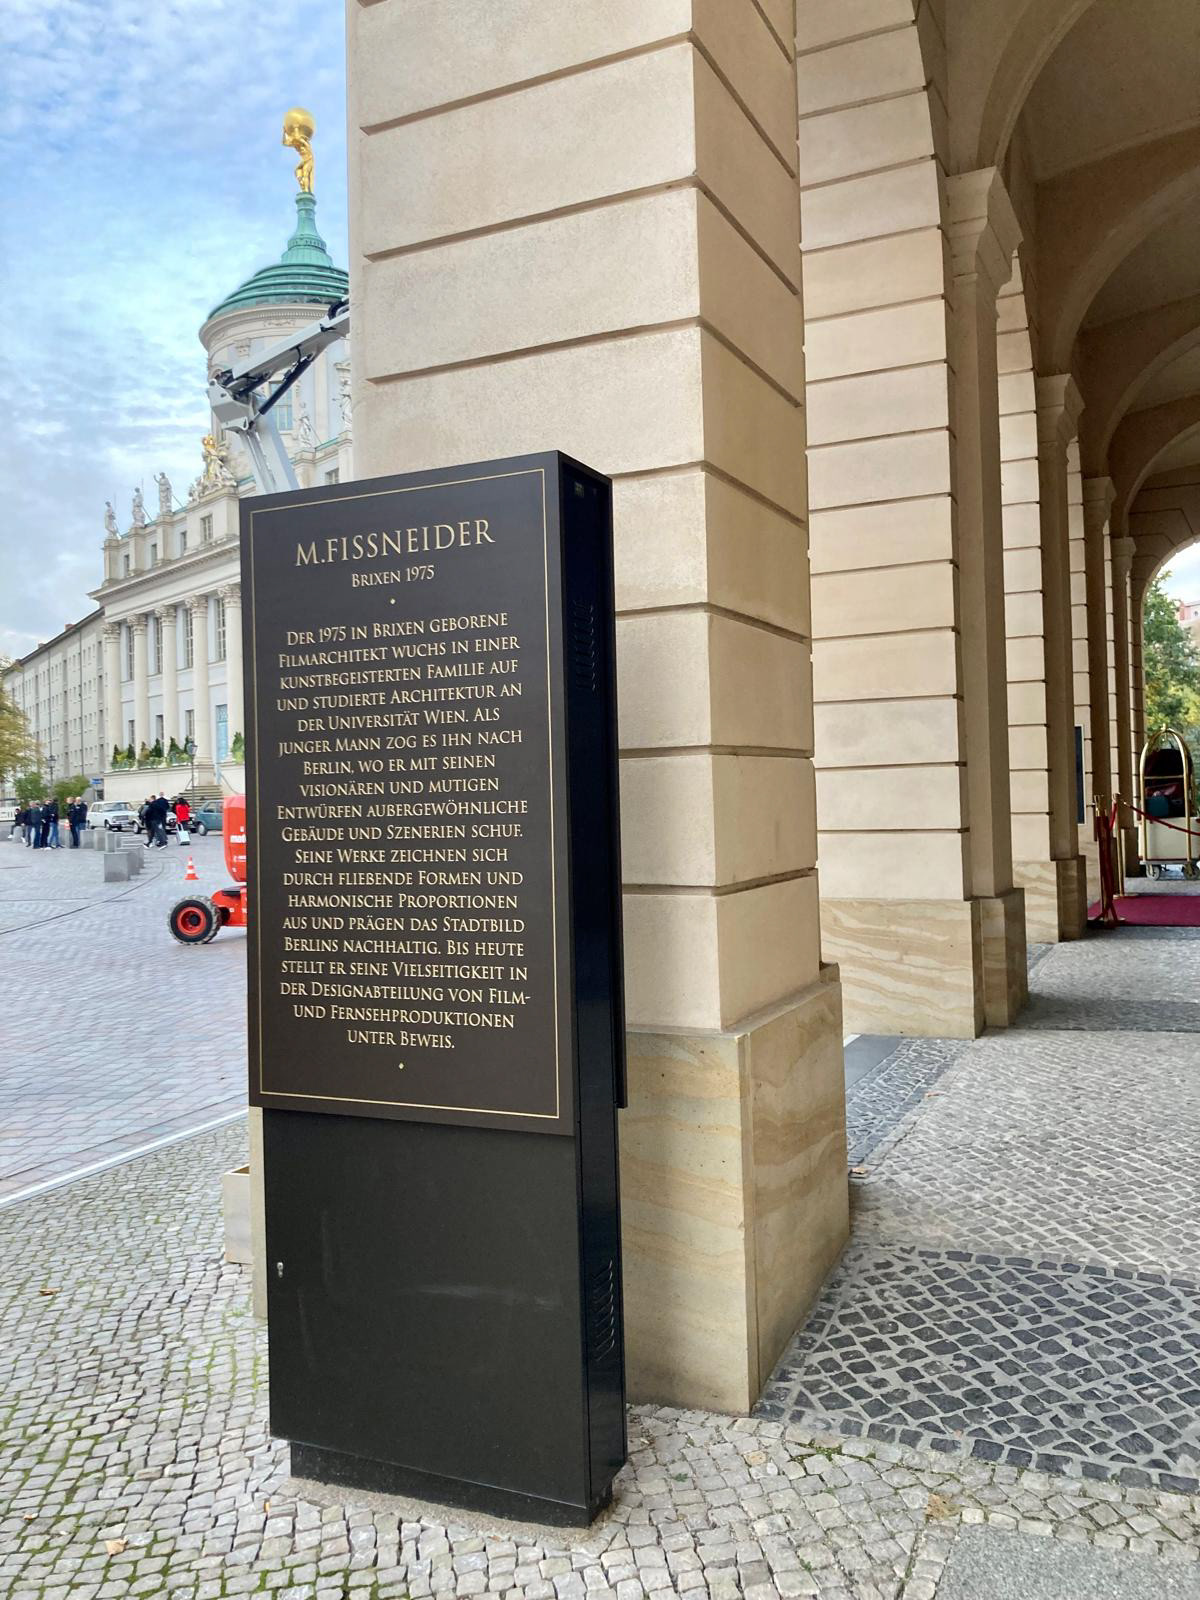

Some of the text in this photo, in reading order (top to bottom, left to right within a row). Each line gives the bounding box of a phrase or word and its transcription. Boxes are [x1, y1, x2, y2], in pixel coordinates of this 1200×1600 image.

[295, 519, 496, 567] M.FISSNEIDER
[351, 564, 435, 588] BRIXEN 1975
[286, 612, 508, 646] DER 1975 IN BRIXEN GEBORENE
[278, 635, 521, 668] FILMARCHITEKT WUCHS IN EINER
[279, 659, 519, 690] KUNSTBEGEISTERTEN FAMILIE AUF
[276, 682, 522, 712] UND STUDIERTE ARCHITEKTUR AN
[297, 707, 500, 732] DER UNIVERSITÄT WIEN. ALS
[278, 729, 523, 758] JUNGER MANN ZOG ES IHN NACH
[303, 754, 496, 776] BERLIN, WO ER MIT SEINEN
[299, 777, 499, 797] VISIONÄREN UND MUTIGEN
[276, 803, 363, 820] ENTWÜRFEN
[281, 823, 523, 842] GEBÄUDE UND SZENERIEN SCHUF.
[294, 848, 508, 864] SEINE WERKE ZEICHNEN SICH
[282, 872, 334, 886] DURCH
[417, 870, 482, 886] FORMEN
[486, 871, 524, 886] UND
[287, 892, 518, 909] HARMONISCHE PROPORTIONEN
[281, 914, 525, 933] AUS UND PRÄGEN DAS STADTBILD
[283, 936, 525, 957] BERLINS NACHHALTIG. BIS HEUTE
[281, 960, 528, 981] STELLT ER SEINE VIELSEITIGKEIT IN
[279, 981, 532, 1005] DER DESIGNABTEILUNG VON FILM-
[292, 1004, 515, 1029] UND FERNSEHPRODUKTIONEN
[346, 1029, 455, 1049] UNTER BEWEIS.
